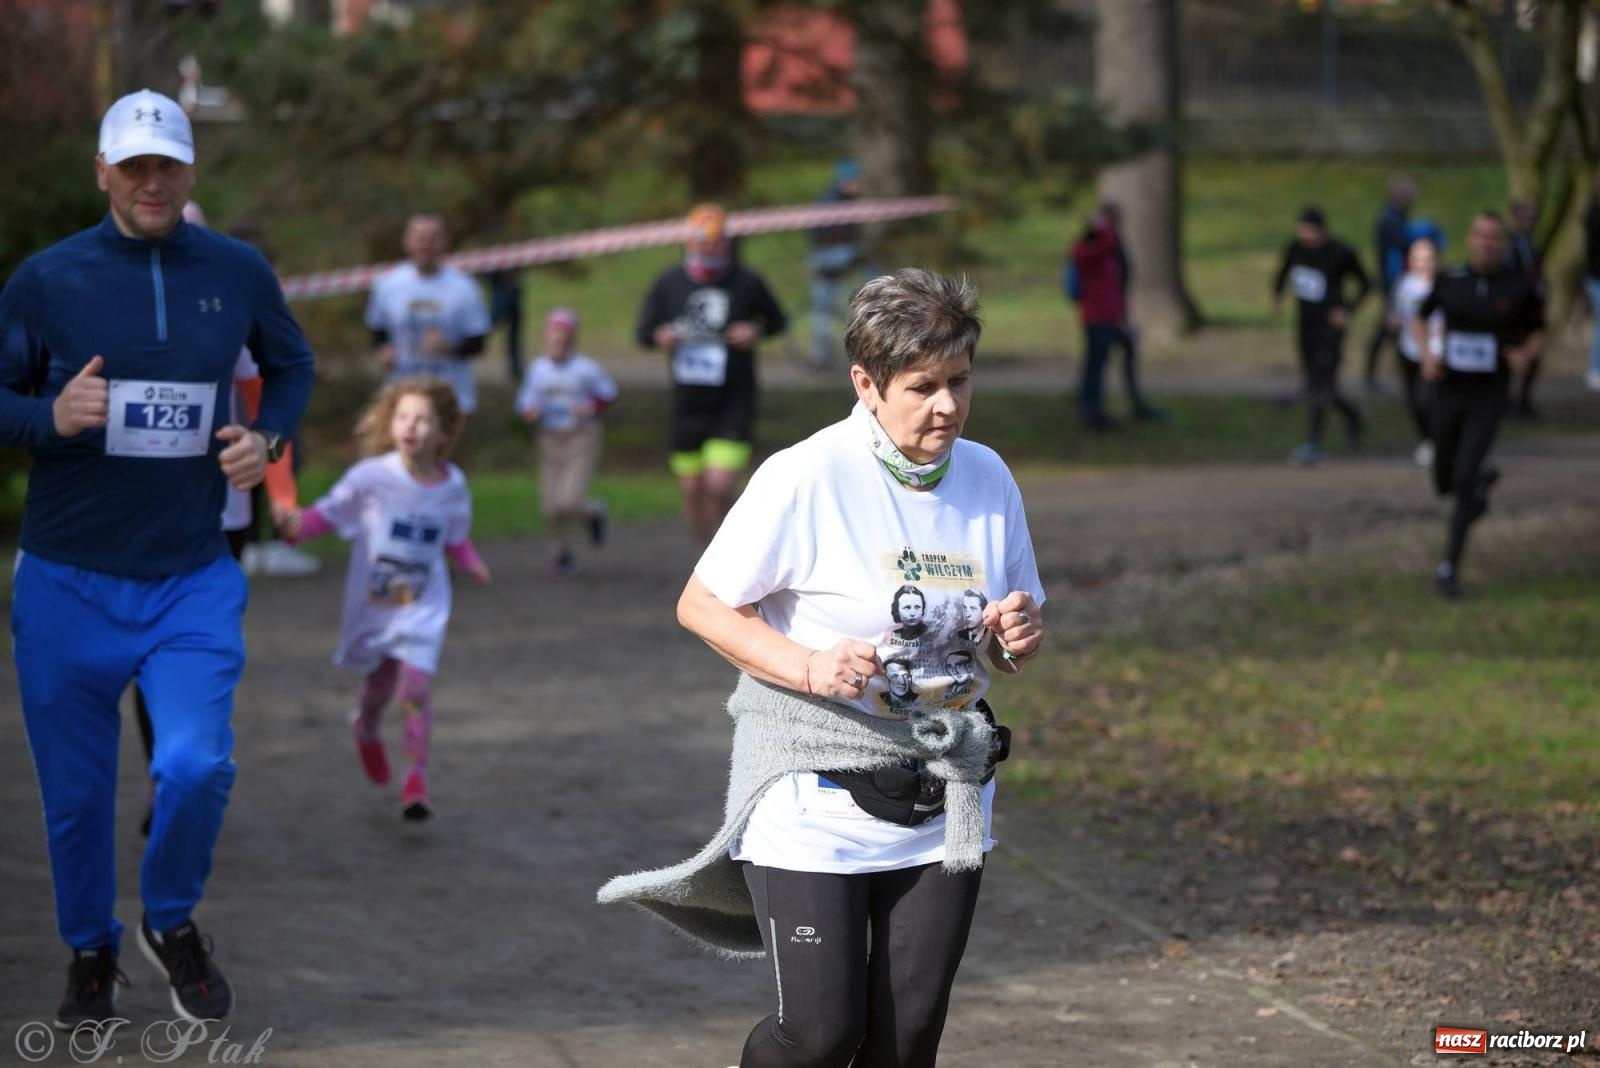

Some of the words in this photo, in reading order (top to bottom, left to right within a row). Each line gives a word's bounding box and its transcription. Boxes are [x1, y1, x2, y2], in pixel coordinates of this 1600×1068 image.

[142, 404, 189, 429] 126
[921, 553, 947, 563] TROPEM
[924, 563, 973, 578] WILCZYM
